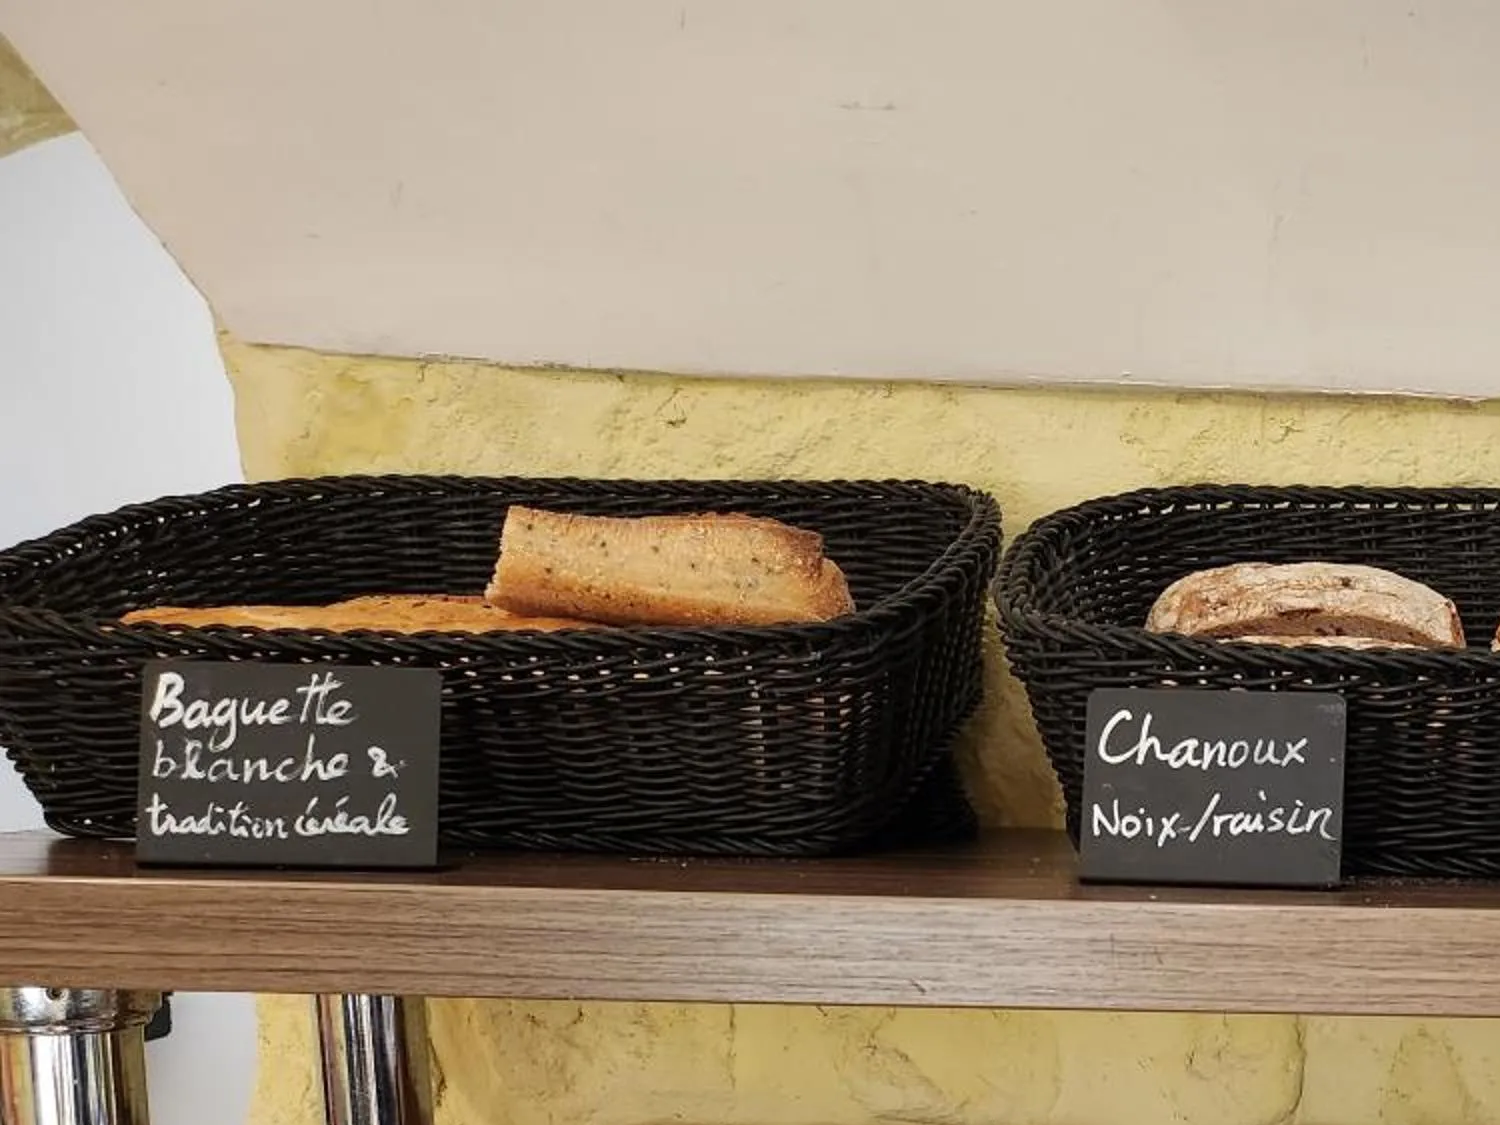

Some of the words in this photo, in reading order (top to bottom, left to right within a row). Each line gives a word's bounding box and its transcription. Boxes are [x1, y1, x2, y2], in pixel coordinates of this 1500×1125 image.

[150, 671, 354, 751] Baguette
[152, 735, 348, 784] blanche
[1098, 709, 1308, 771] Chanoux
[146, 793, 289, 839] tradition
